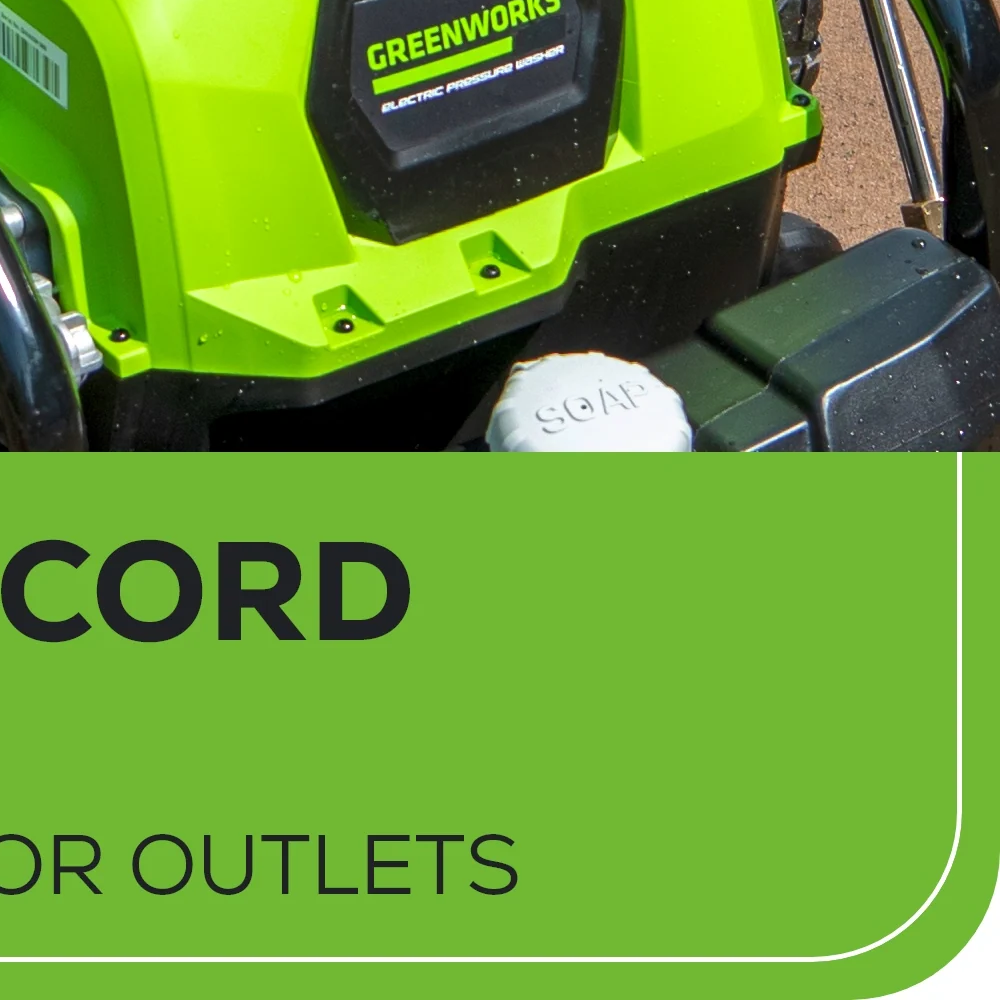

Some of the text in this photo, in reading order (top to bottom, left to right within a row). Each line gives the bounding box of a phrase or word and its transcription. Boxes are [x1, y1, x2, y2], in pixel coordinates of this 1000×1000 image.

[381, 86, 445, 114] ELECTRIC
[446, 62, 514, 94] PRESSURE
[535, 380, 649, 435] SOAP
